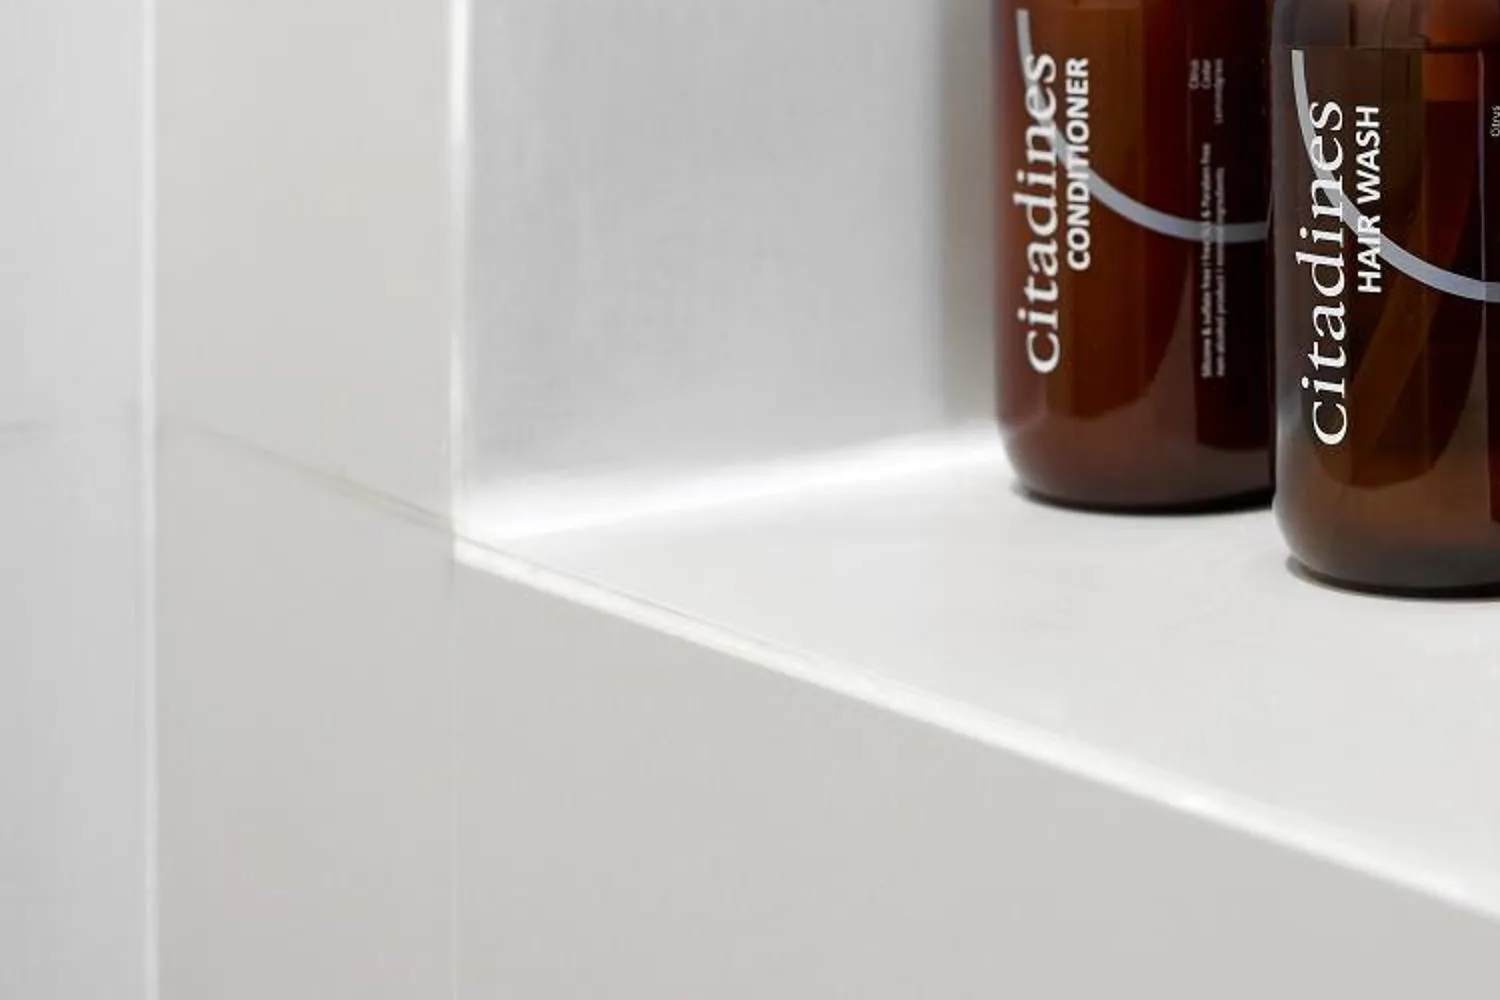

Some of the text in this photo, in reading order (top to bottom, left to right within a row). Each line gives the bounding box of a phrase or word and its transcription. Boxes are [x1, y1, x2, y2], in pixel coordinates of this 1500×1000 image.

[1012, 53, 1060, 374] citadines
[1065, 58, 1091, 271] CONDITIONER
[1355, 106, 1382, 293] HAIR WASH
[1490, 104, 1500, 137] Citrus
[1295, 100, 1347, 446] citadines
